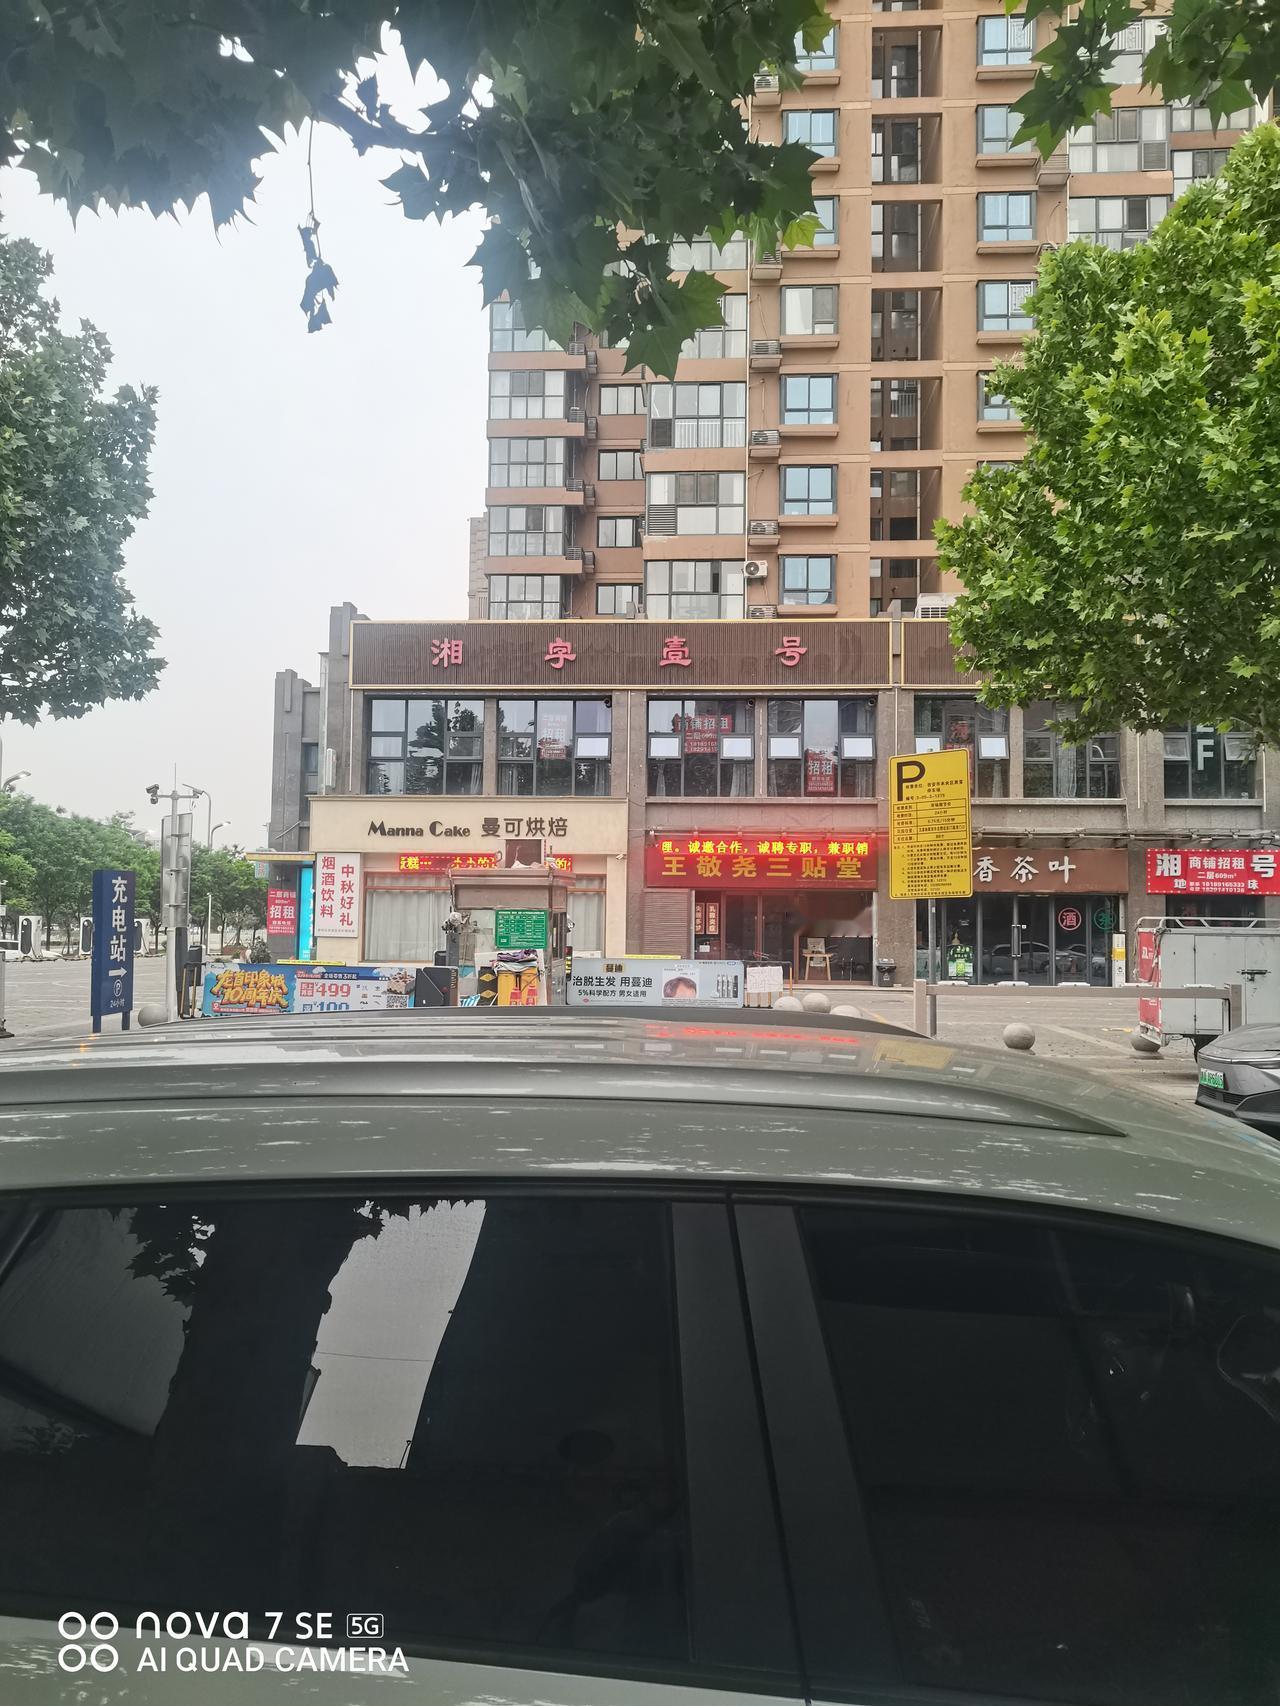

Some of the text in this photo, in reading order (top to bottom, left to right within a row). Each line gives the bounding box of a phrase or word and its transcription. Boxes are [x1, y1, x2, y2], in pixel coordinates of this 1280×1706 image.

[897, 761, 926, 801] P
[368, 817, 568, 837] Manna Cake 曼可烘焙
[661, 856, 862, 878] 王敬尧三贴堂
[973, 855, 1077, 884] 香茶叶
[1188, 856, 1246, 870] 商铺招租
[1250, 854, 1277, 878] 号
[320, 856, 336, 918] 烟酒饮料
[339, 864, 355, 926] 中秋好礼
[110, 876, 128, 962] 充电站
[269, 905, 295, 919] 招租
[1062, 912, 1077, 926] 酒
[572, 975, 616, 987] 治脱生发
